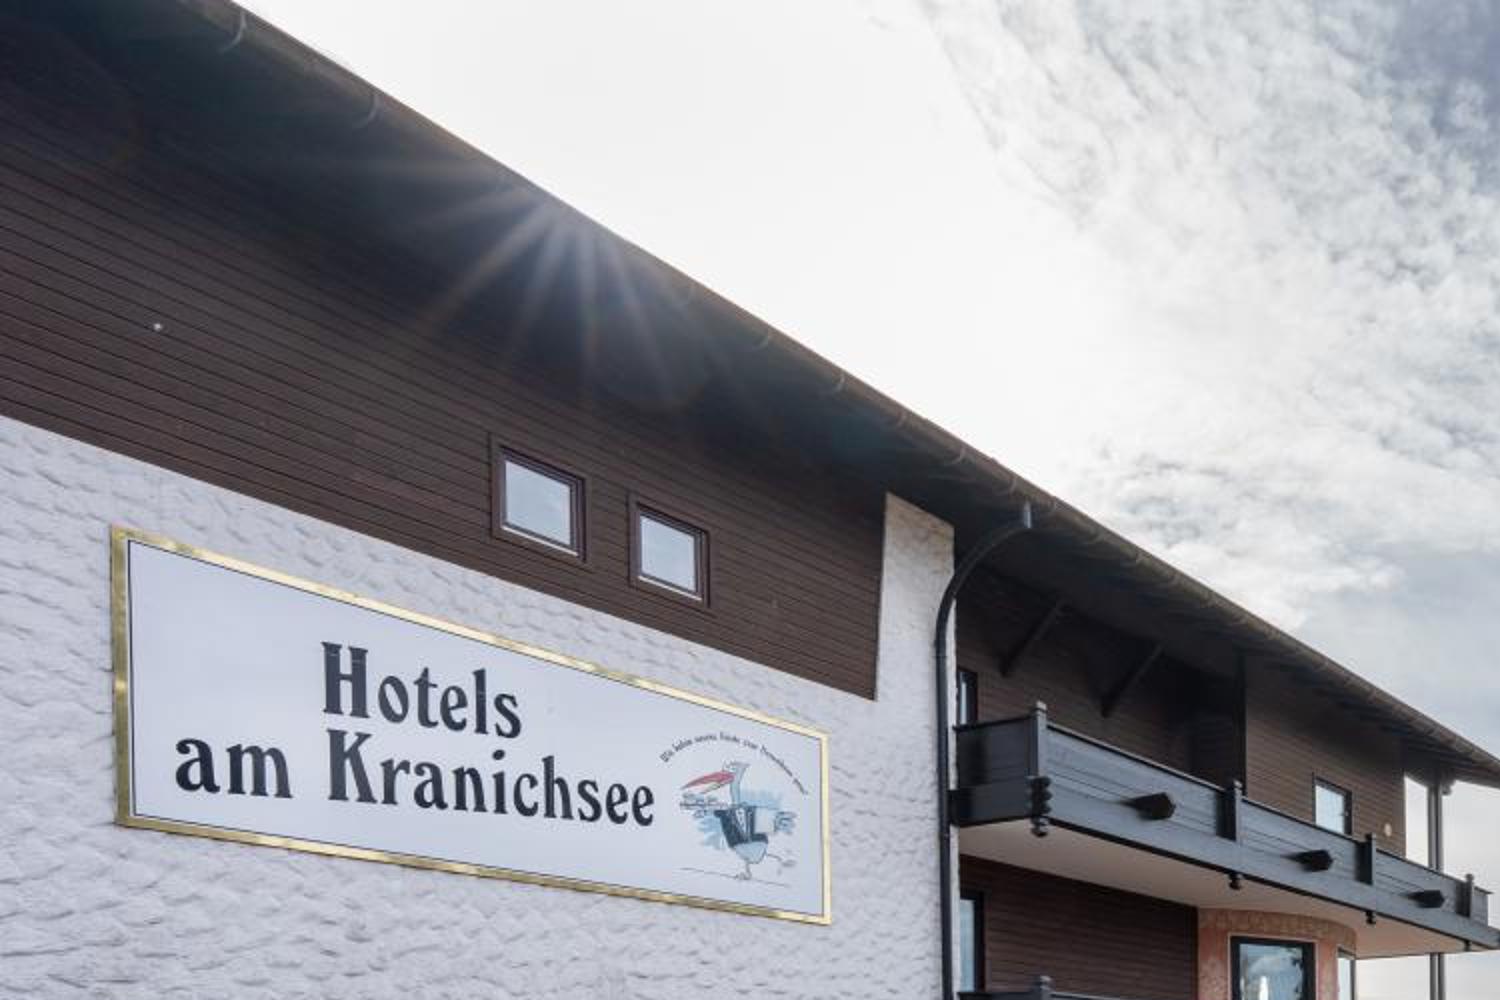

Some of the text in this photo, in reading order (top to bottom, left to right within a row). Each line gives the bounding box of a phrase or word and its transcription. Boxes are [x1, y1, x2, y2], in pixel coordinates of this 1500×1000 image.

[321, 641, 523, 739] Hotels
[174, 737, 294, 799] am
[326, 728, 655, 828] Kranichsee
